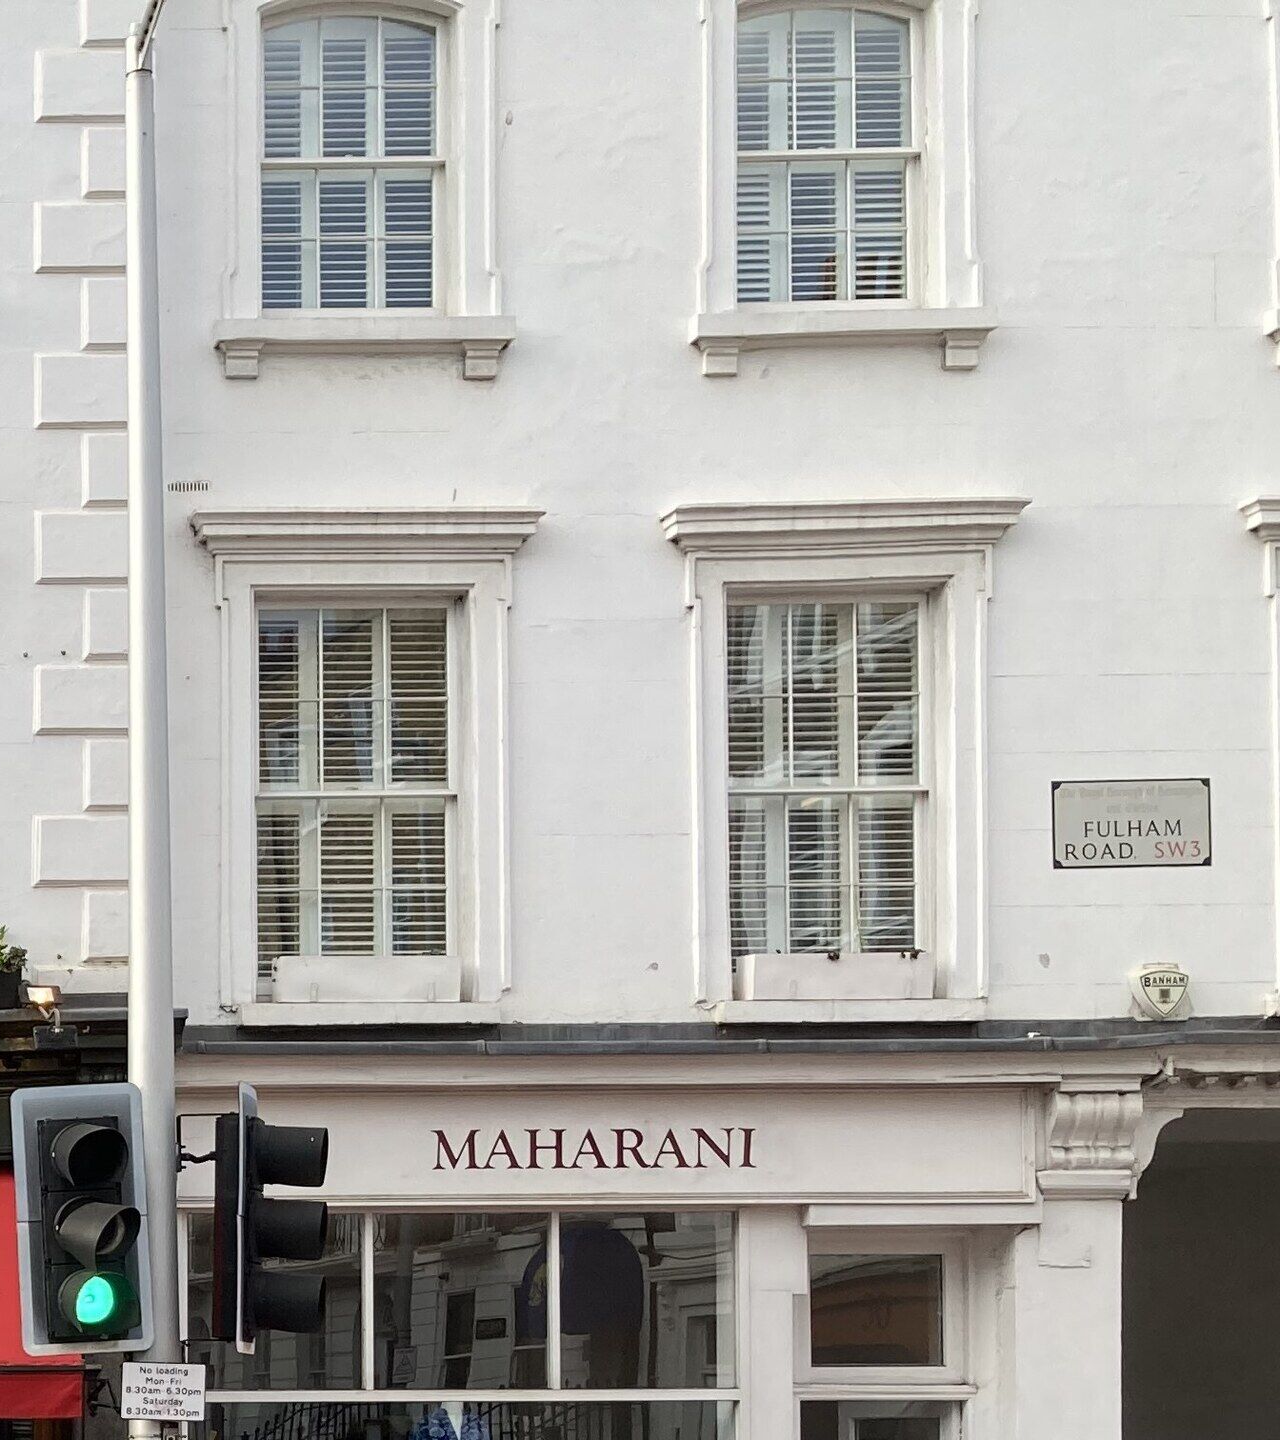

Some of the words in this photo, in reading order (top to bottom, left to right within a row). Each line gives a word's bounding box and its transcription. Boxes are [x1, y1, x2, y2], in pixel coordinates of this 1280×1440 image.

[1084, 819, 1182, 838] FULHAM
[1155, 840, 1202, 859] SW3
[1144, 976, 1186, 988] BANHAM
[430, 1128, 757, 1171] MAHARANI
[139, 1366, 152, 1374] No
[156, 1367, 189, 1376] loading
[142, 1397, 184, 1406] Saturday
